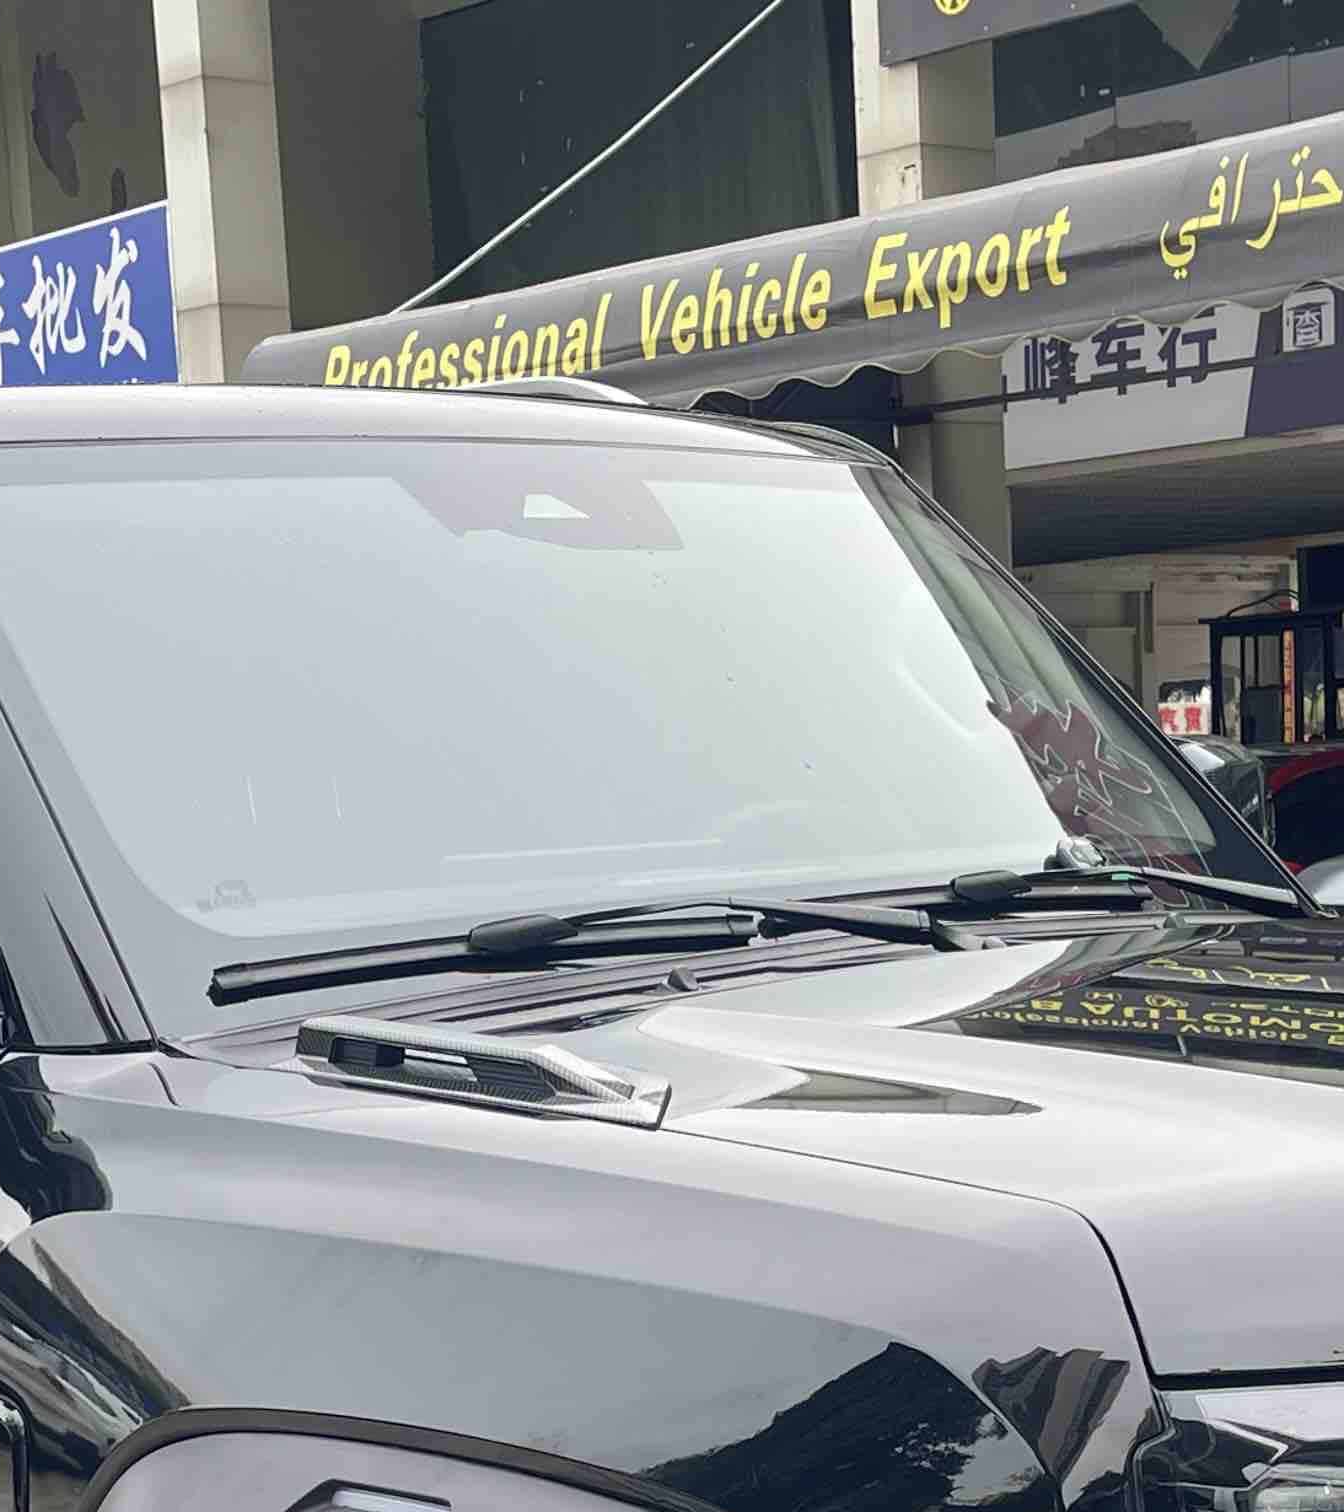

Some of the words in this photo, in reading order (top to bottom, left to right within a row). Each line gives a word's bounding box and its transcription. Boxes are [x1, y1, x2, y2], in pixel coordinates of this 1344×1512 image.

[324, 292, 613, 388] Professional
[637, 251, 833, 358] Vehicle
[863, 205, 1071, 329] Export
